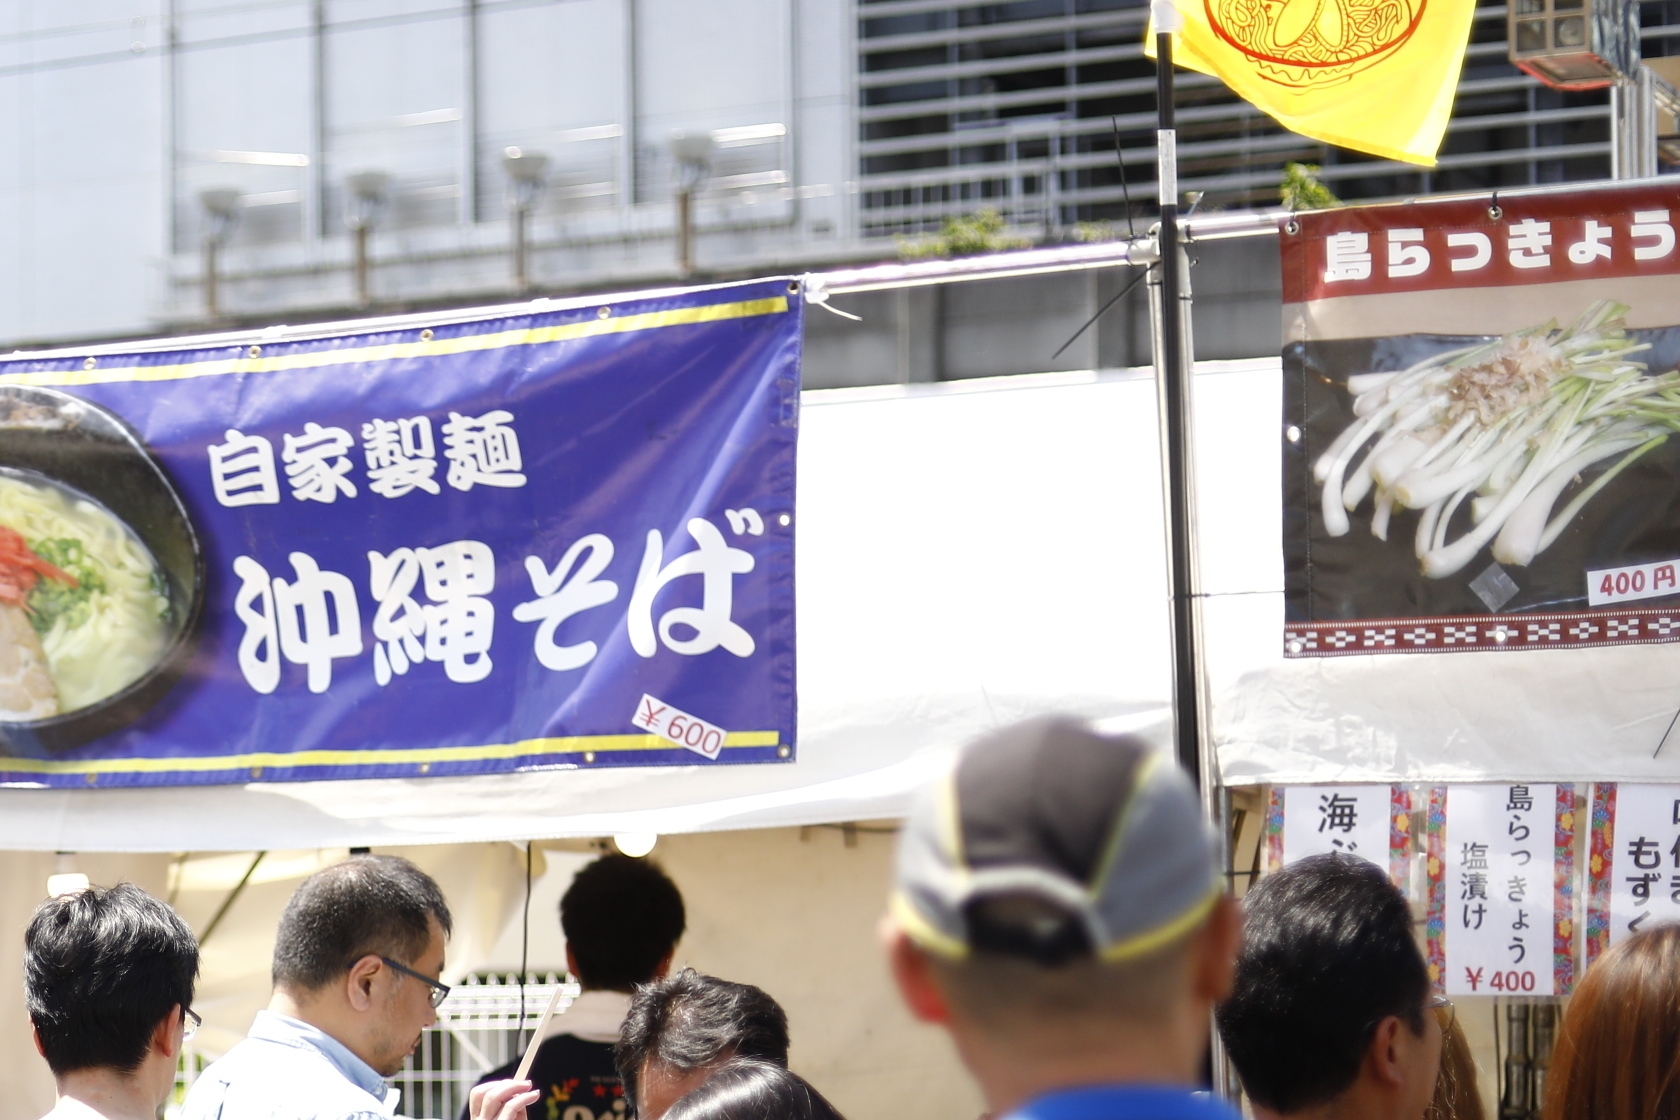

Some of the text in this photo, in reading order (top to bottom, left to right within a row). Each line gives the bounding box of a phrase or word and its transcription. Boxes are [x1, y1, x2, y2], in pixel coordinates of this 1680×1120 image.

[208, 410, 528, 507] 自家製麺
[231, 507, 765, 694] 沖縄そば
[1460, 841, 1489, 931] 塩漬け
[1505, 784, 1534, 965] 島らっきょう
[1625, 836, 1663, 933] もずく
